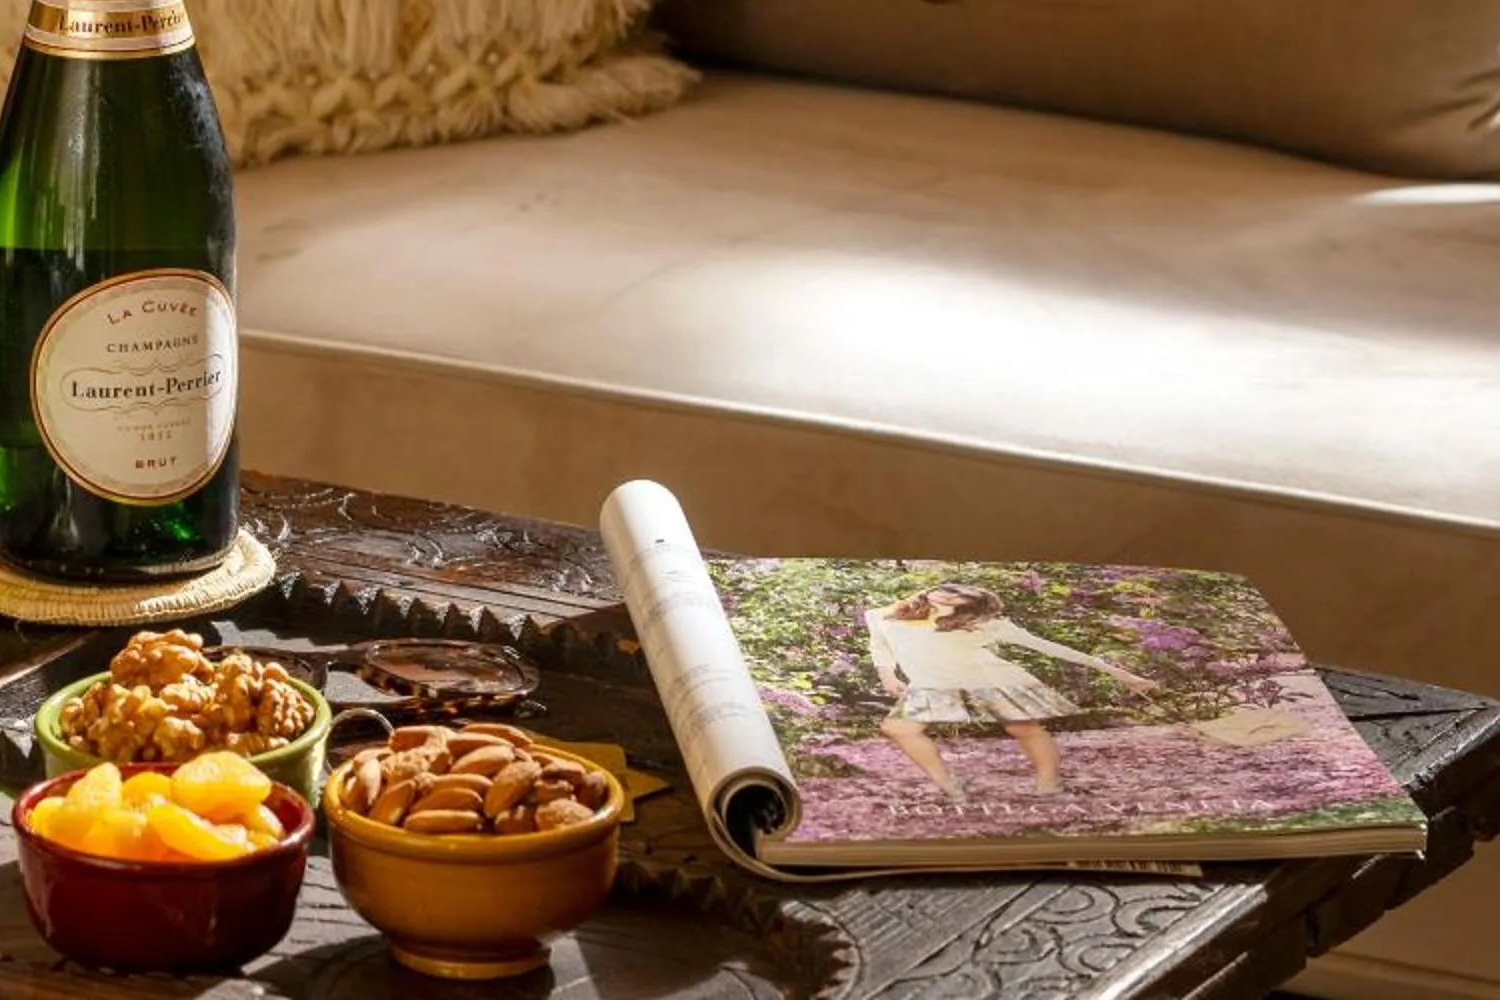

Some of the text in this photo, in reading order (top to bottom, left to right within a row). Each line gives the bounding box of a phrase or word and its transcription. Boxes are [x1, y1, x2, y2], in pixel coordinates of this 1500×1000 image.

[58, 9, 182, 33] Laurent-Perri
[107, 310, 133, 325] LA
[106, 334, 199, 353] CHAMPAGNE
[70, 370, 221, 398] Laurent-Perrier
[135, 456, 177, 469] BRUT
